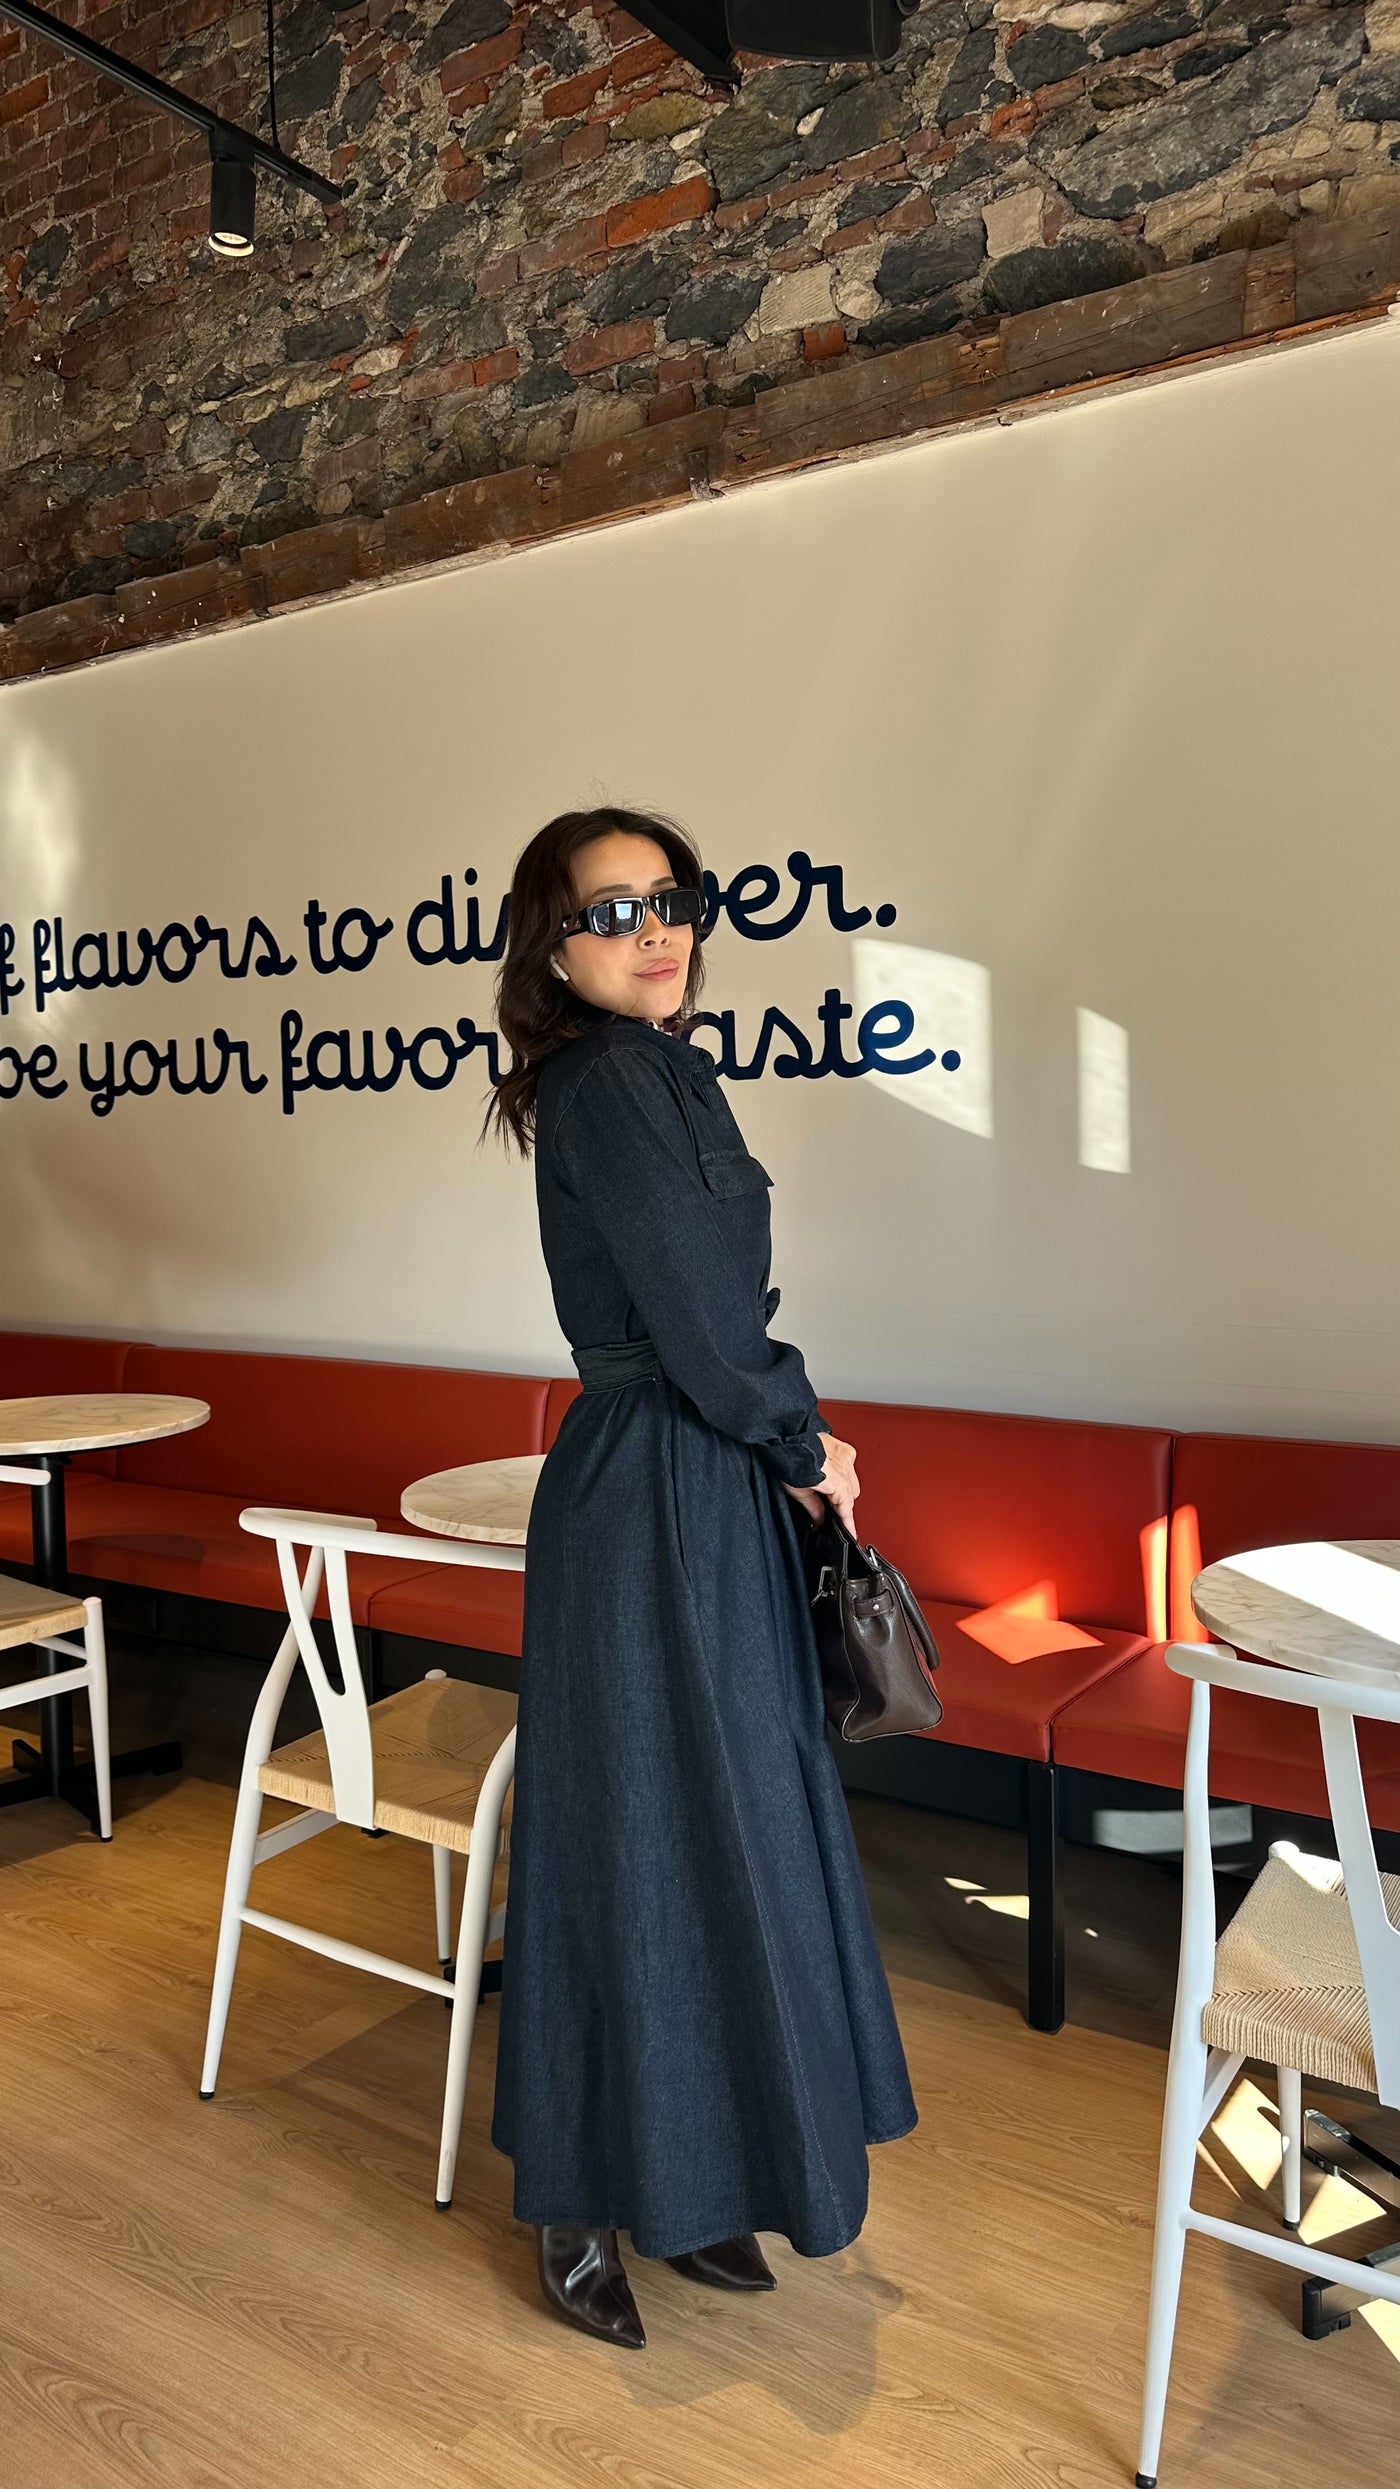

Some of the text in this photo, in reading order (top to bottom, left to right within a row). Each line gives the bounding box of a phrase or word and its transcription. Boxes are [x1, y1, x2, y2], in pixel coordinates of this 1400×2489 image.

[0, 923, 25, 1015] f
[33, 915, 298, 1013] flavors
[303, 899, 394, 974] to
[79, 1028, 268, 1118] your
[280, 1009, 503, 1116] favor
[682, 989, 961, 1082] aste.
